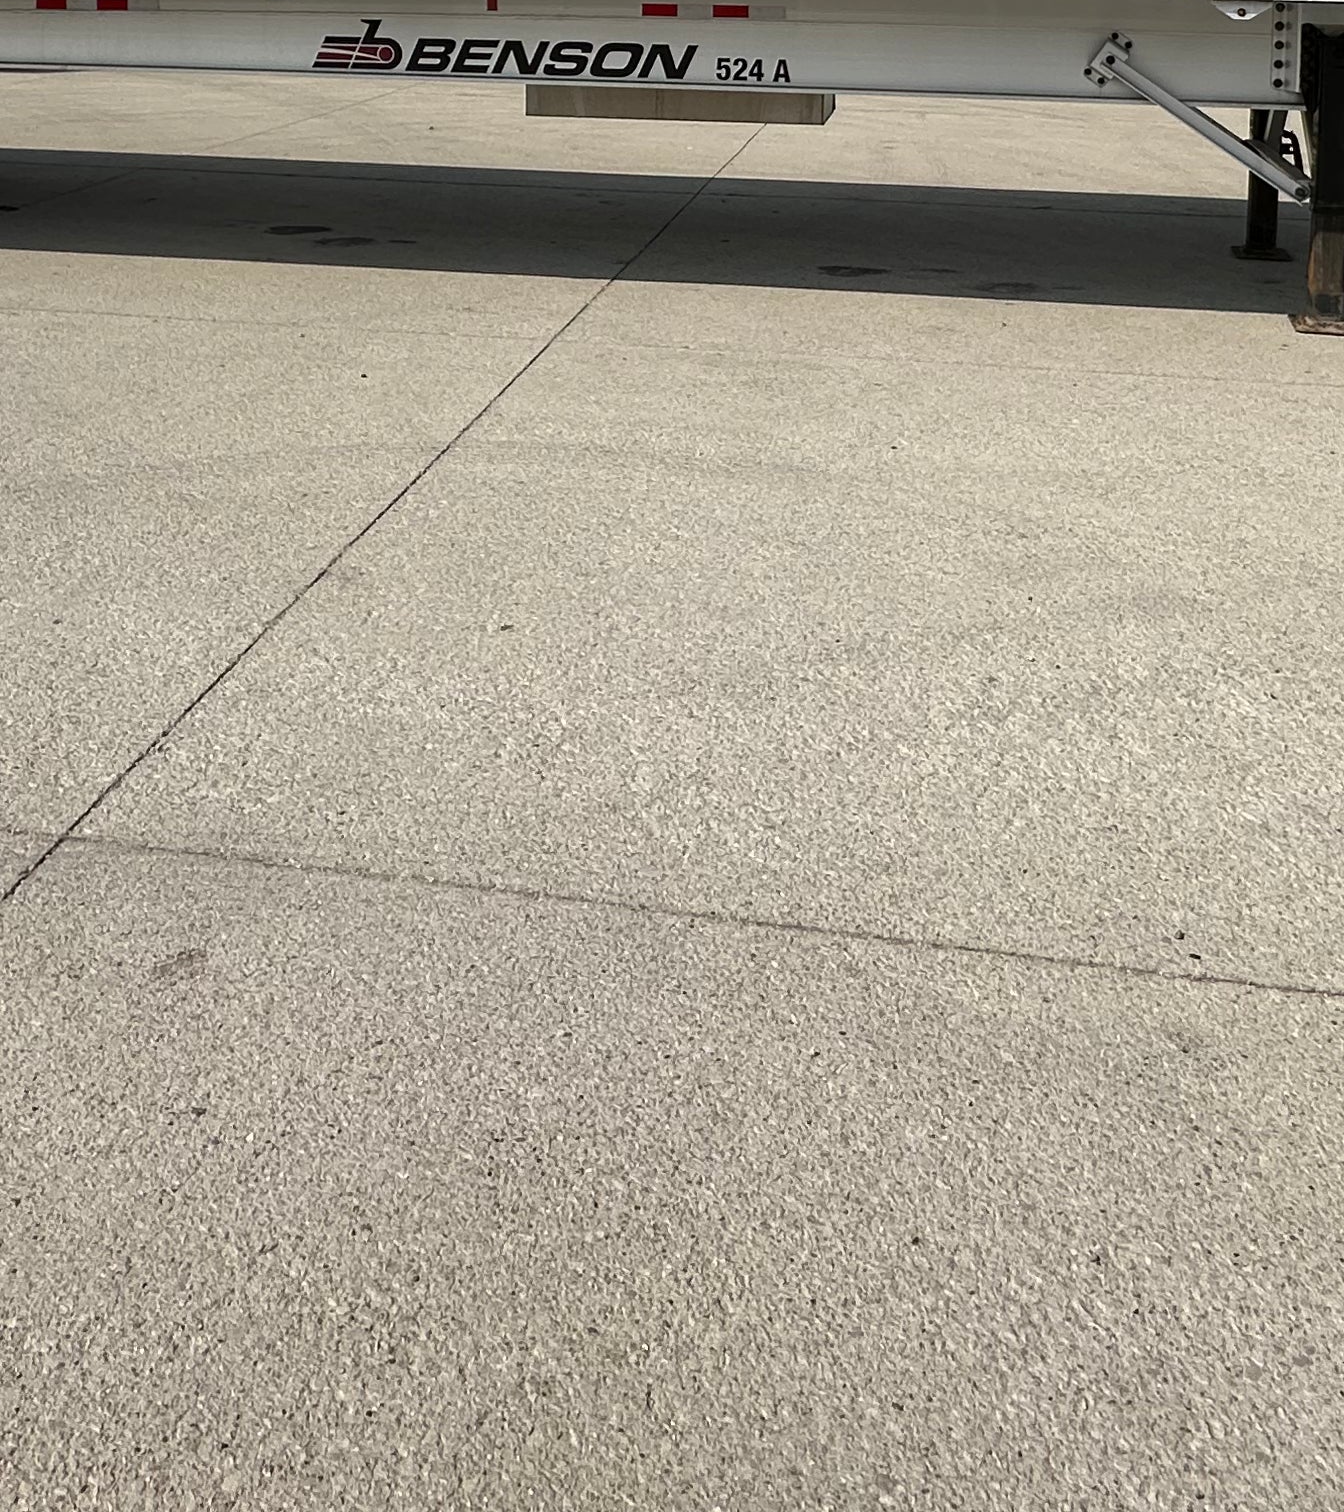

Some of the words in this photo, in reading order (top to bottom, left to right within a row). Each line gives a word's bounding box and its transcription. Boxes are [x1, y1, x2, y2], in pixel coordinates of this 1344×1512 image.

[405, 37, 698, 80] BENSON
[716, 57, 765, 83] 524
[773, 58, 791, 83] A
